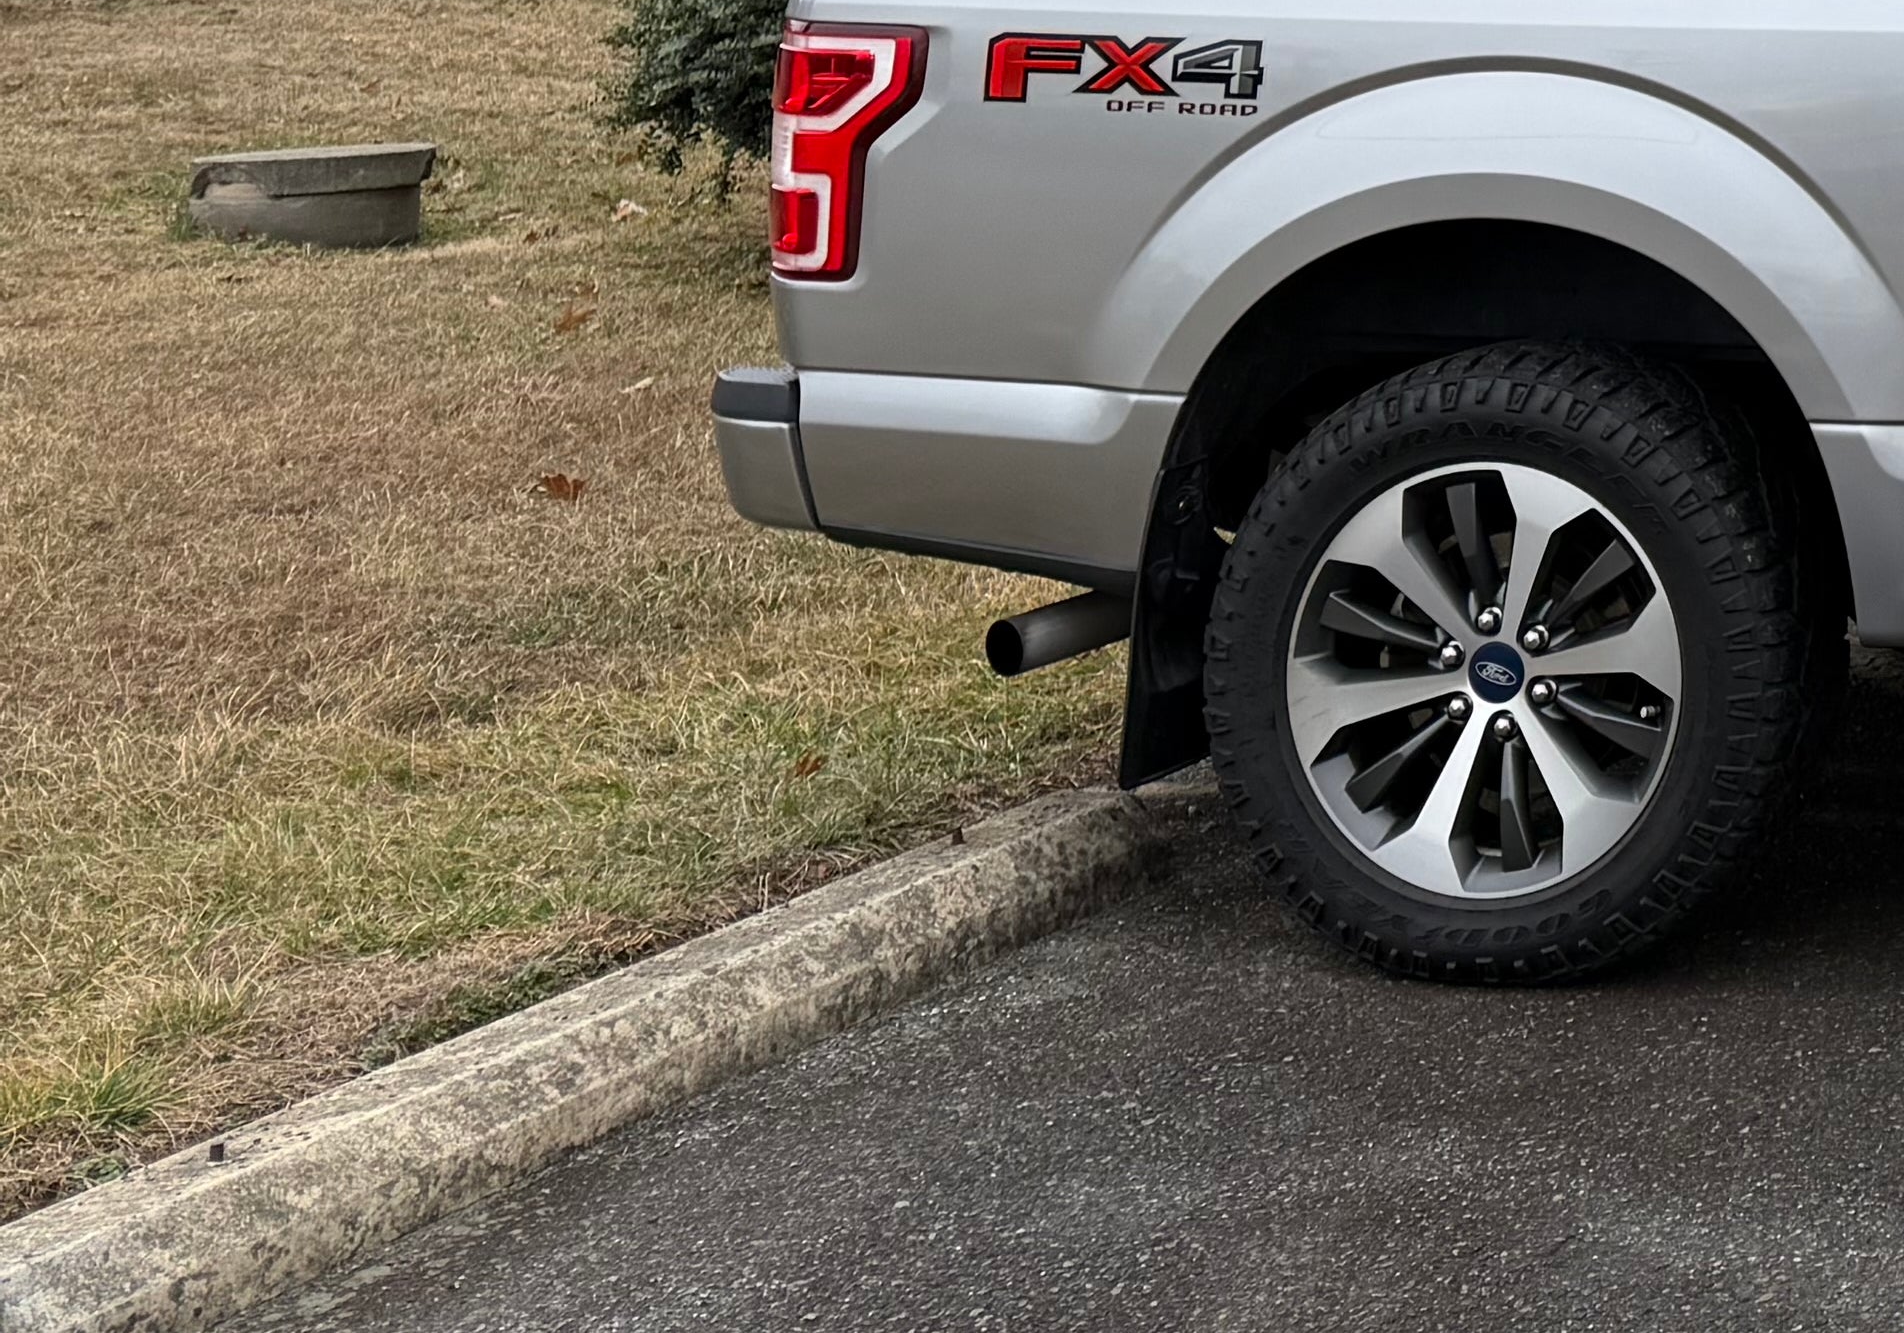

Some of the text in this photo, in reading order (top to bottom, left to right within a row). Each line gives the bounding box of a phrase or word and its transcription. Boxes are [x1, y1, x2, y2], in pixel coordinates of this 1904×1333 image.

[984, 32, 1264, 102] FX4
[1106, 99, 1258, 116] OFF ROAD
[1480, 664, 1510, 683] Ford
